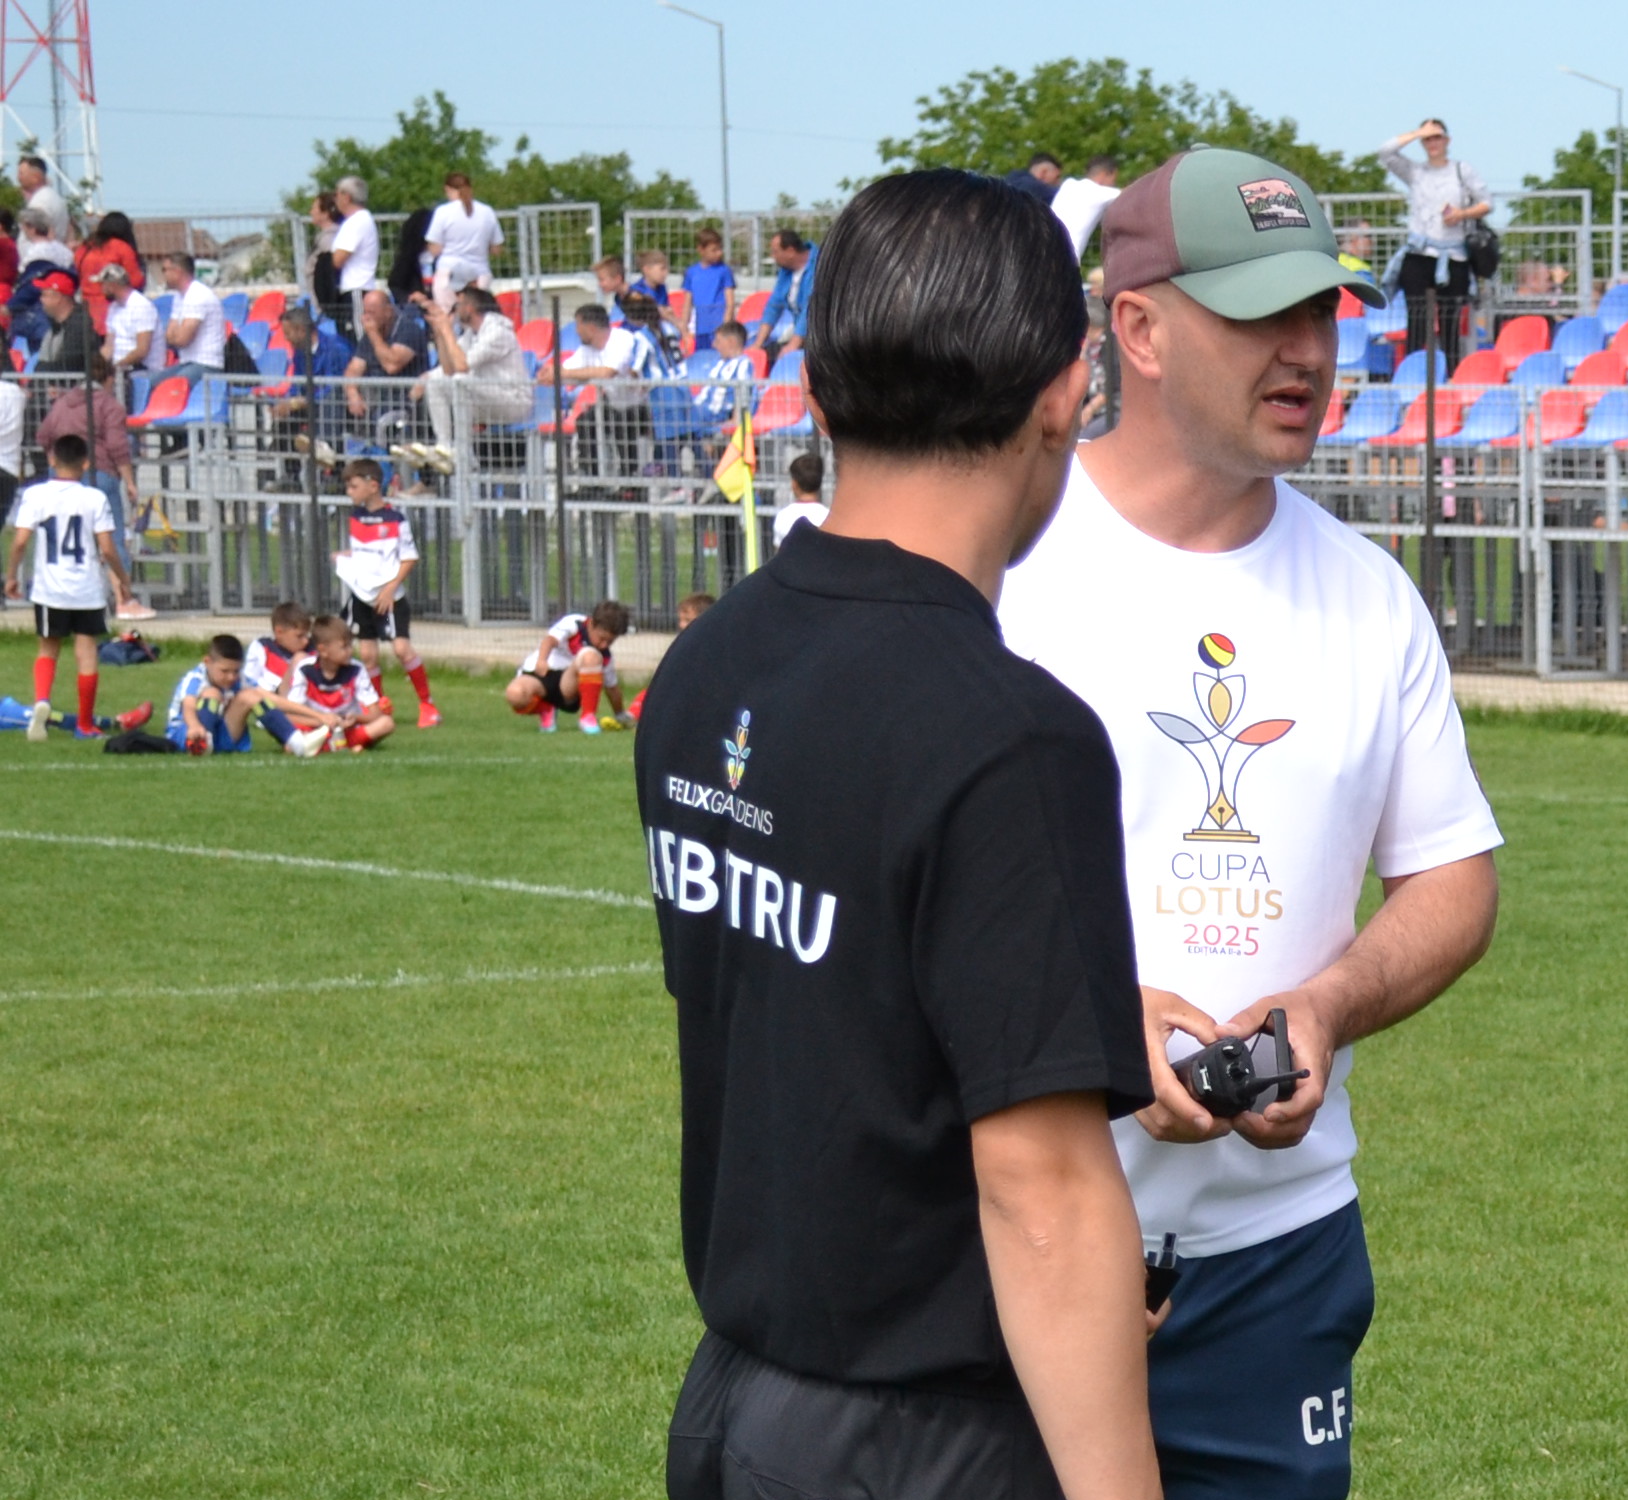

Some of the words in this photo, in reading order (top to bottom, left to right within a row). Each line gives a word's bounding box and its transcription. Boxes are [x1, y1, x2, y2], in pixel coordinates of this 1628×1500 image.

[38, 515, 85, 565] 14
[668, 774, 774, 836] FELIXGADENS
[1171, 852, 1271, 884] CUPA
[1155, 885, 1283, 920] LOTUS
[1183, 923, 1260, 957] 2025
